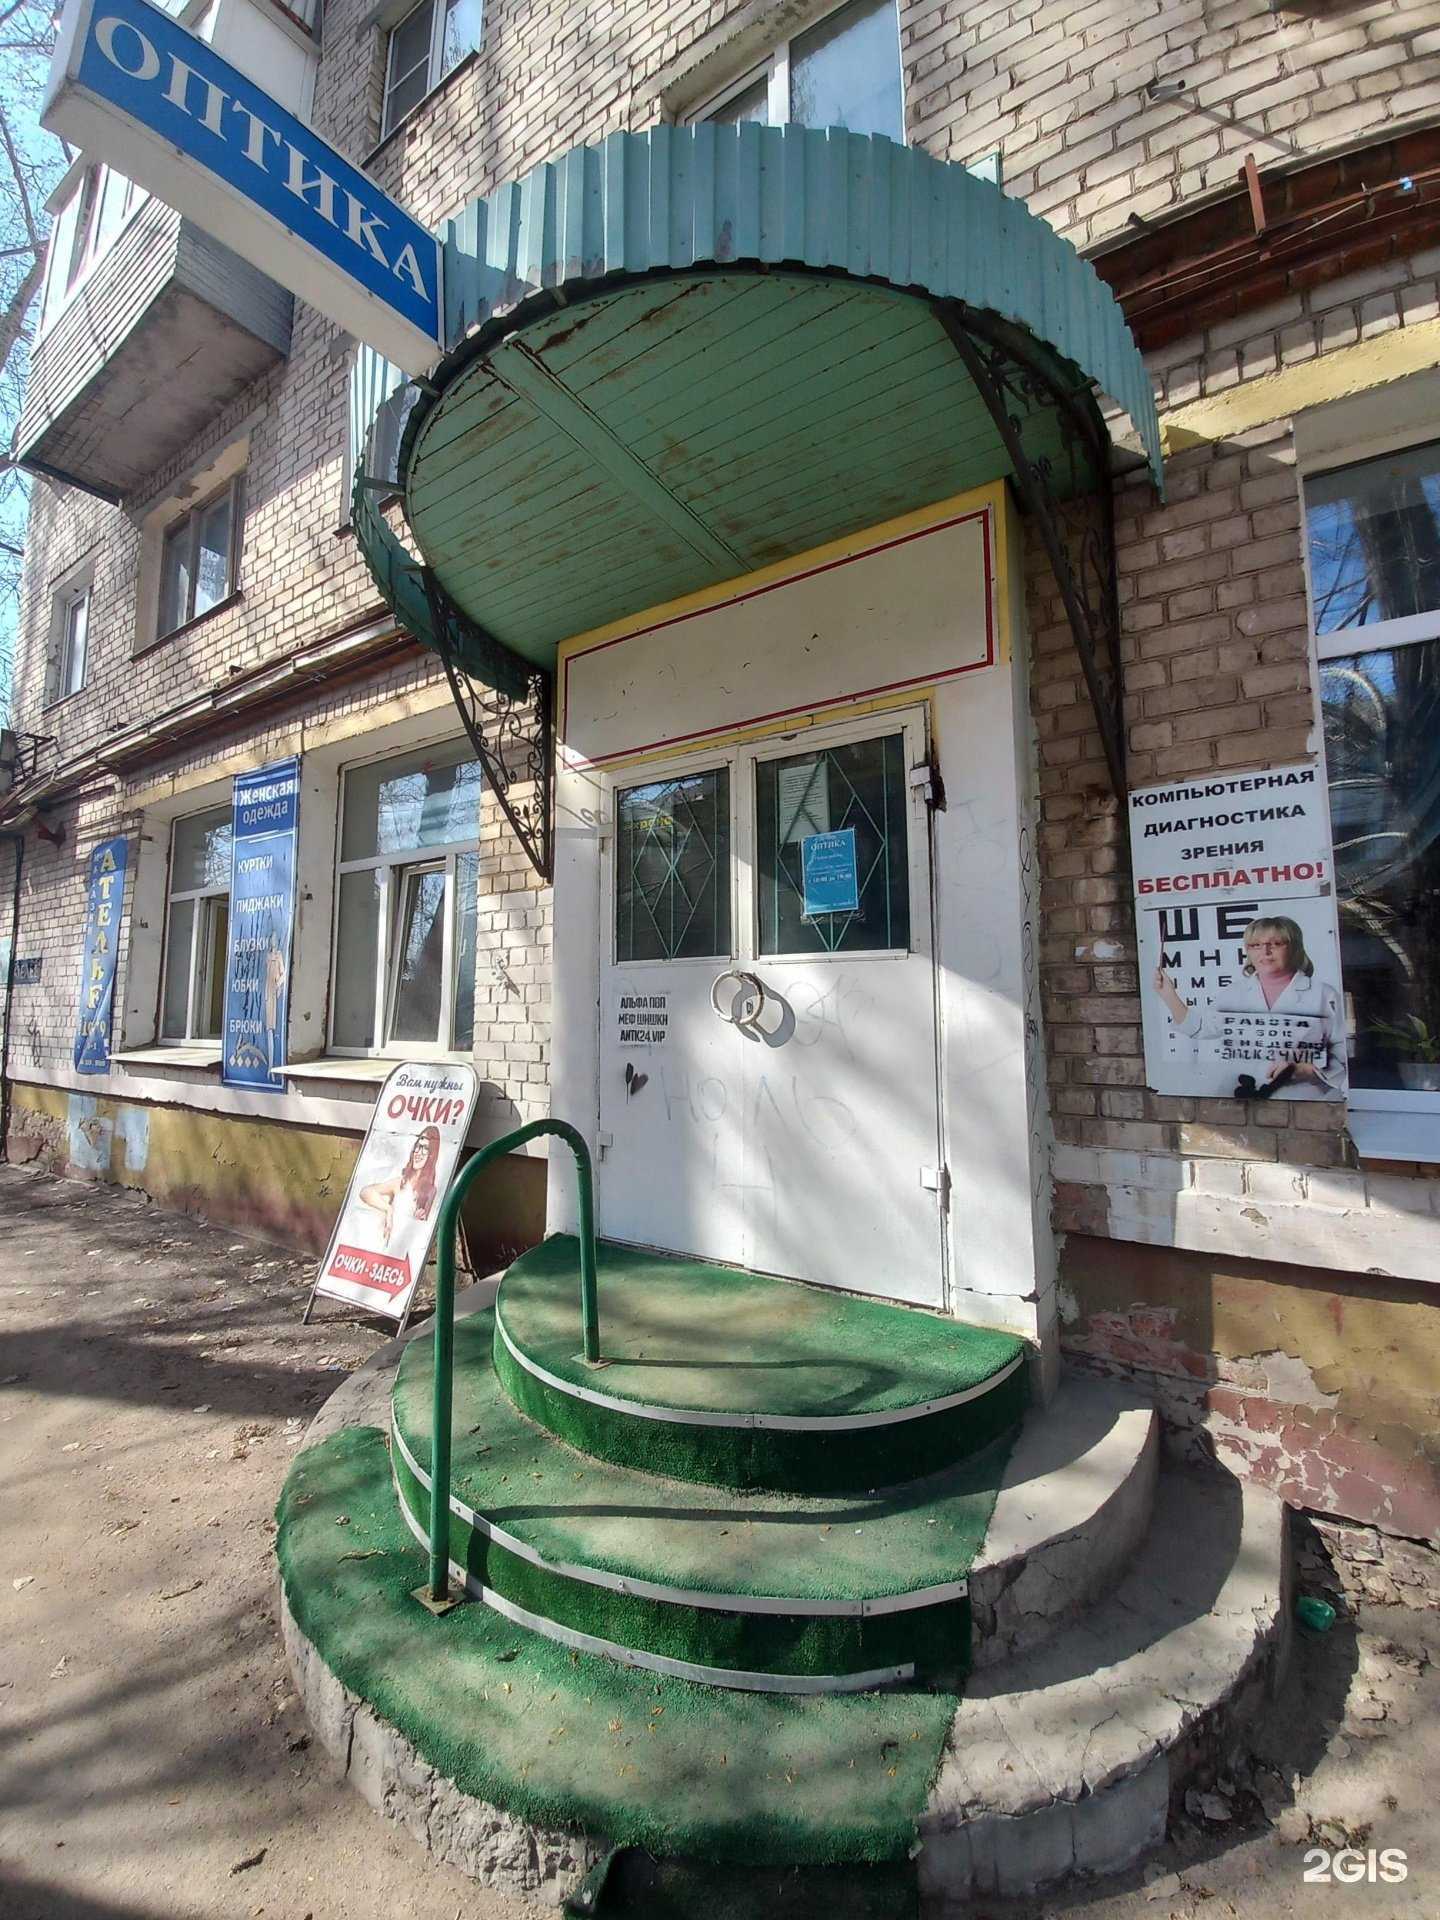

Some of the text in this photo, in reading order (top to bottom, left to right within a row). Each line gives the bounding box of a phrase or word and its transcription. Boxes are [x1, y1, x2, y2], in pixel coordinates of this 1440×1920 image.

[94, 17, 431, 304] ОПТИКА
[239, 780, 294, 807] Женская
[1132, 769, 1315, 808] КОМПЬЮТЕРНАЯ
[242, 800, 288, 826] одежда
[1144, 804, 1306, 838] ДИАГНОСТИКА
[1181, 840, 1265, 860] ЗРЕНИЯ
[237, 855, 273, 874] КУРТКИ
[1138, 861, 1324, 894] БЕСПЛАТНО!
[236, 894, 284, 915] ПИДЖАКИ
[233, 937, 269, 952] БЛУЗКИ
[231, 979, 259, 993] ЮБКИ
[620, 996, 648, 1009] АЛЬФА
[229, 1019, 262, 1034] БРЮКИ
[618, 1013, 636, 1025] МЕФ
[396, 1074, 464, 1094] Вам нужны
[387, 1094, 465, 1125] ОЧКИ?
